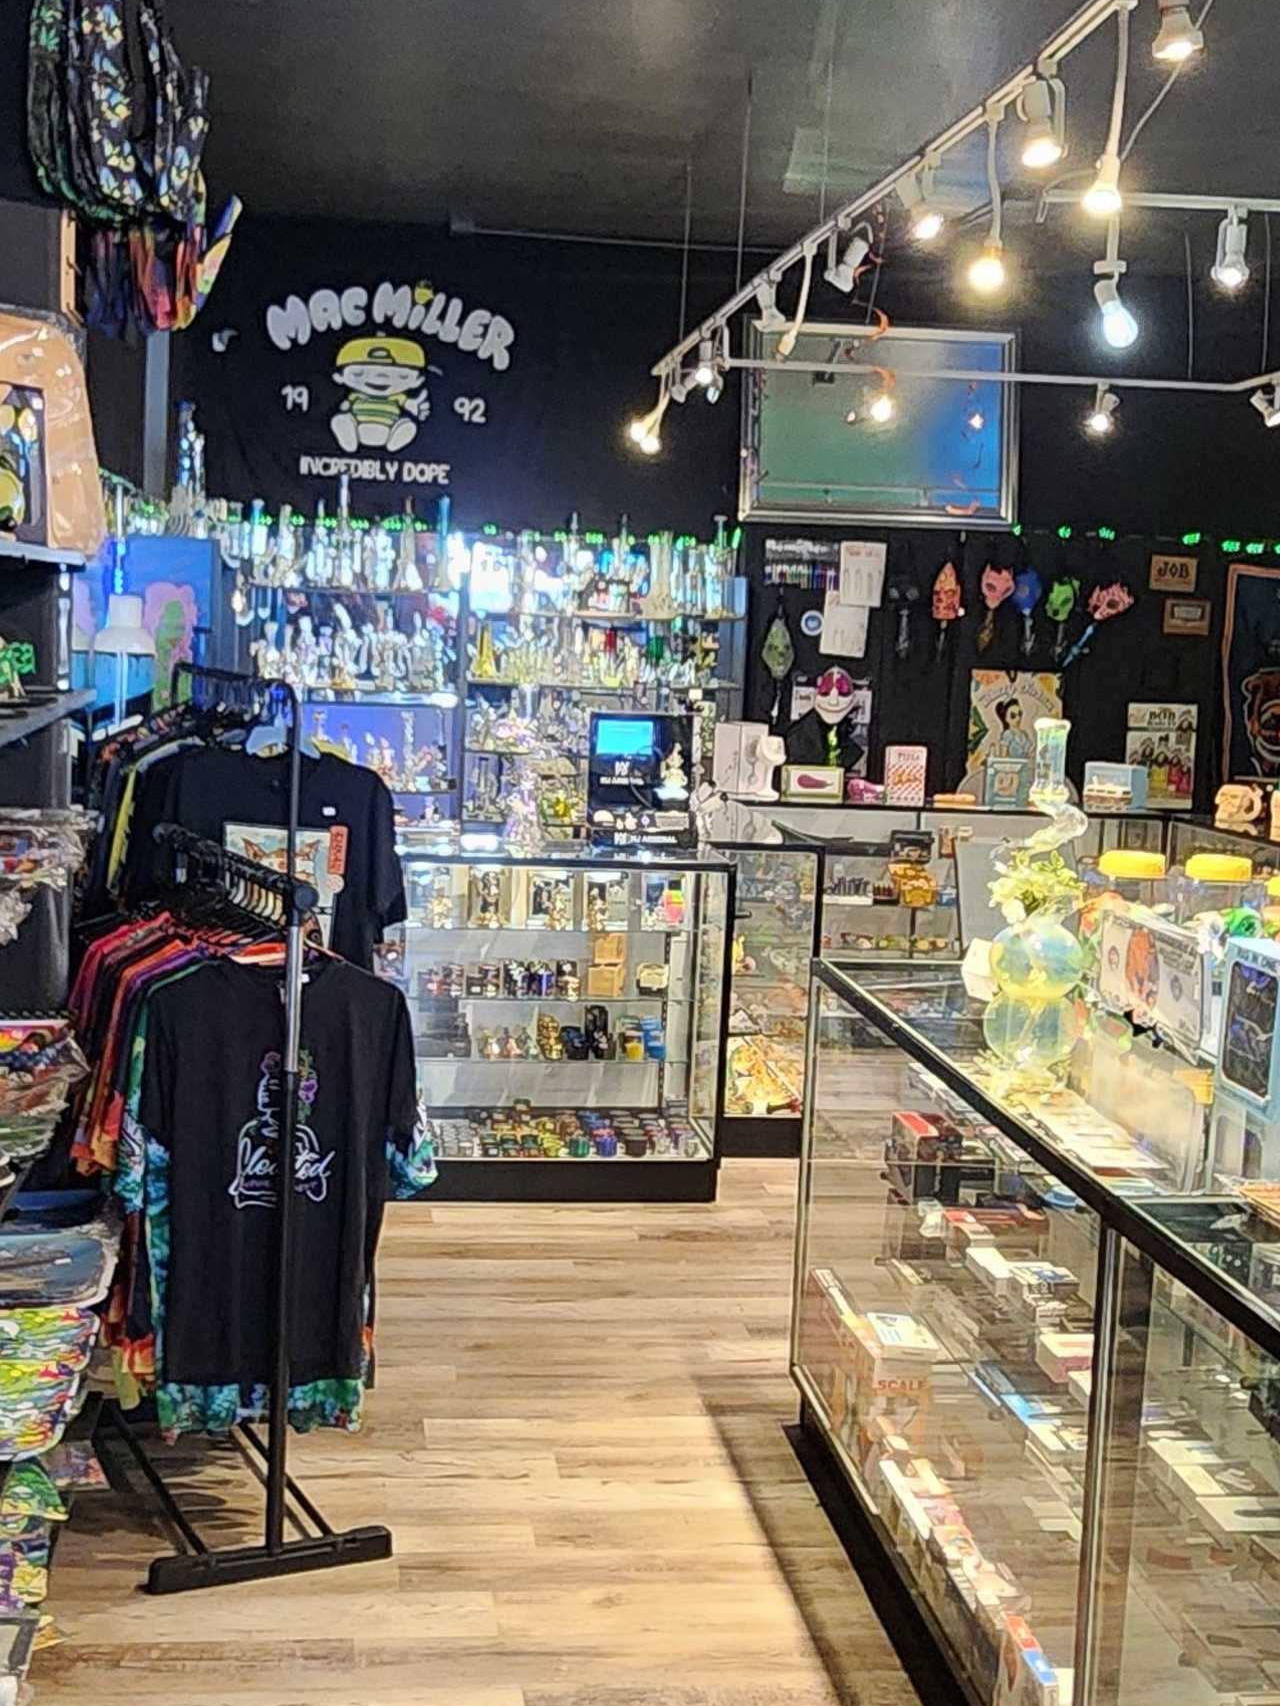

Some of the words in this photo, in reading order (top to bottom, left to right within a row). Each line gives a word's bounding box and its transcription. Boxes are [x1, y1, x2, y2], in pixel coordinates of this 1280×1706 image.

[266, 286, 368, 351] MAC
[281, 385, 310, 413] 19
[453, 397, 487, 425] 92
[299, 456, 400, 481] INCREDIBLY
[403, 462, 451, 484] DOPE
[1157, 562, 1190, 580] JOB
